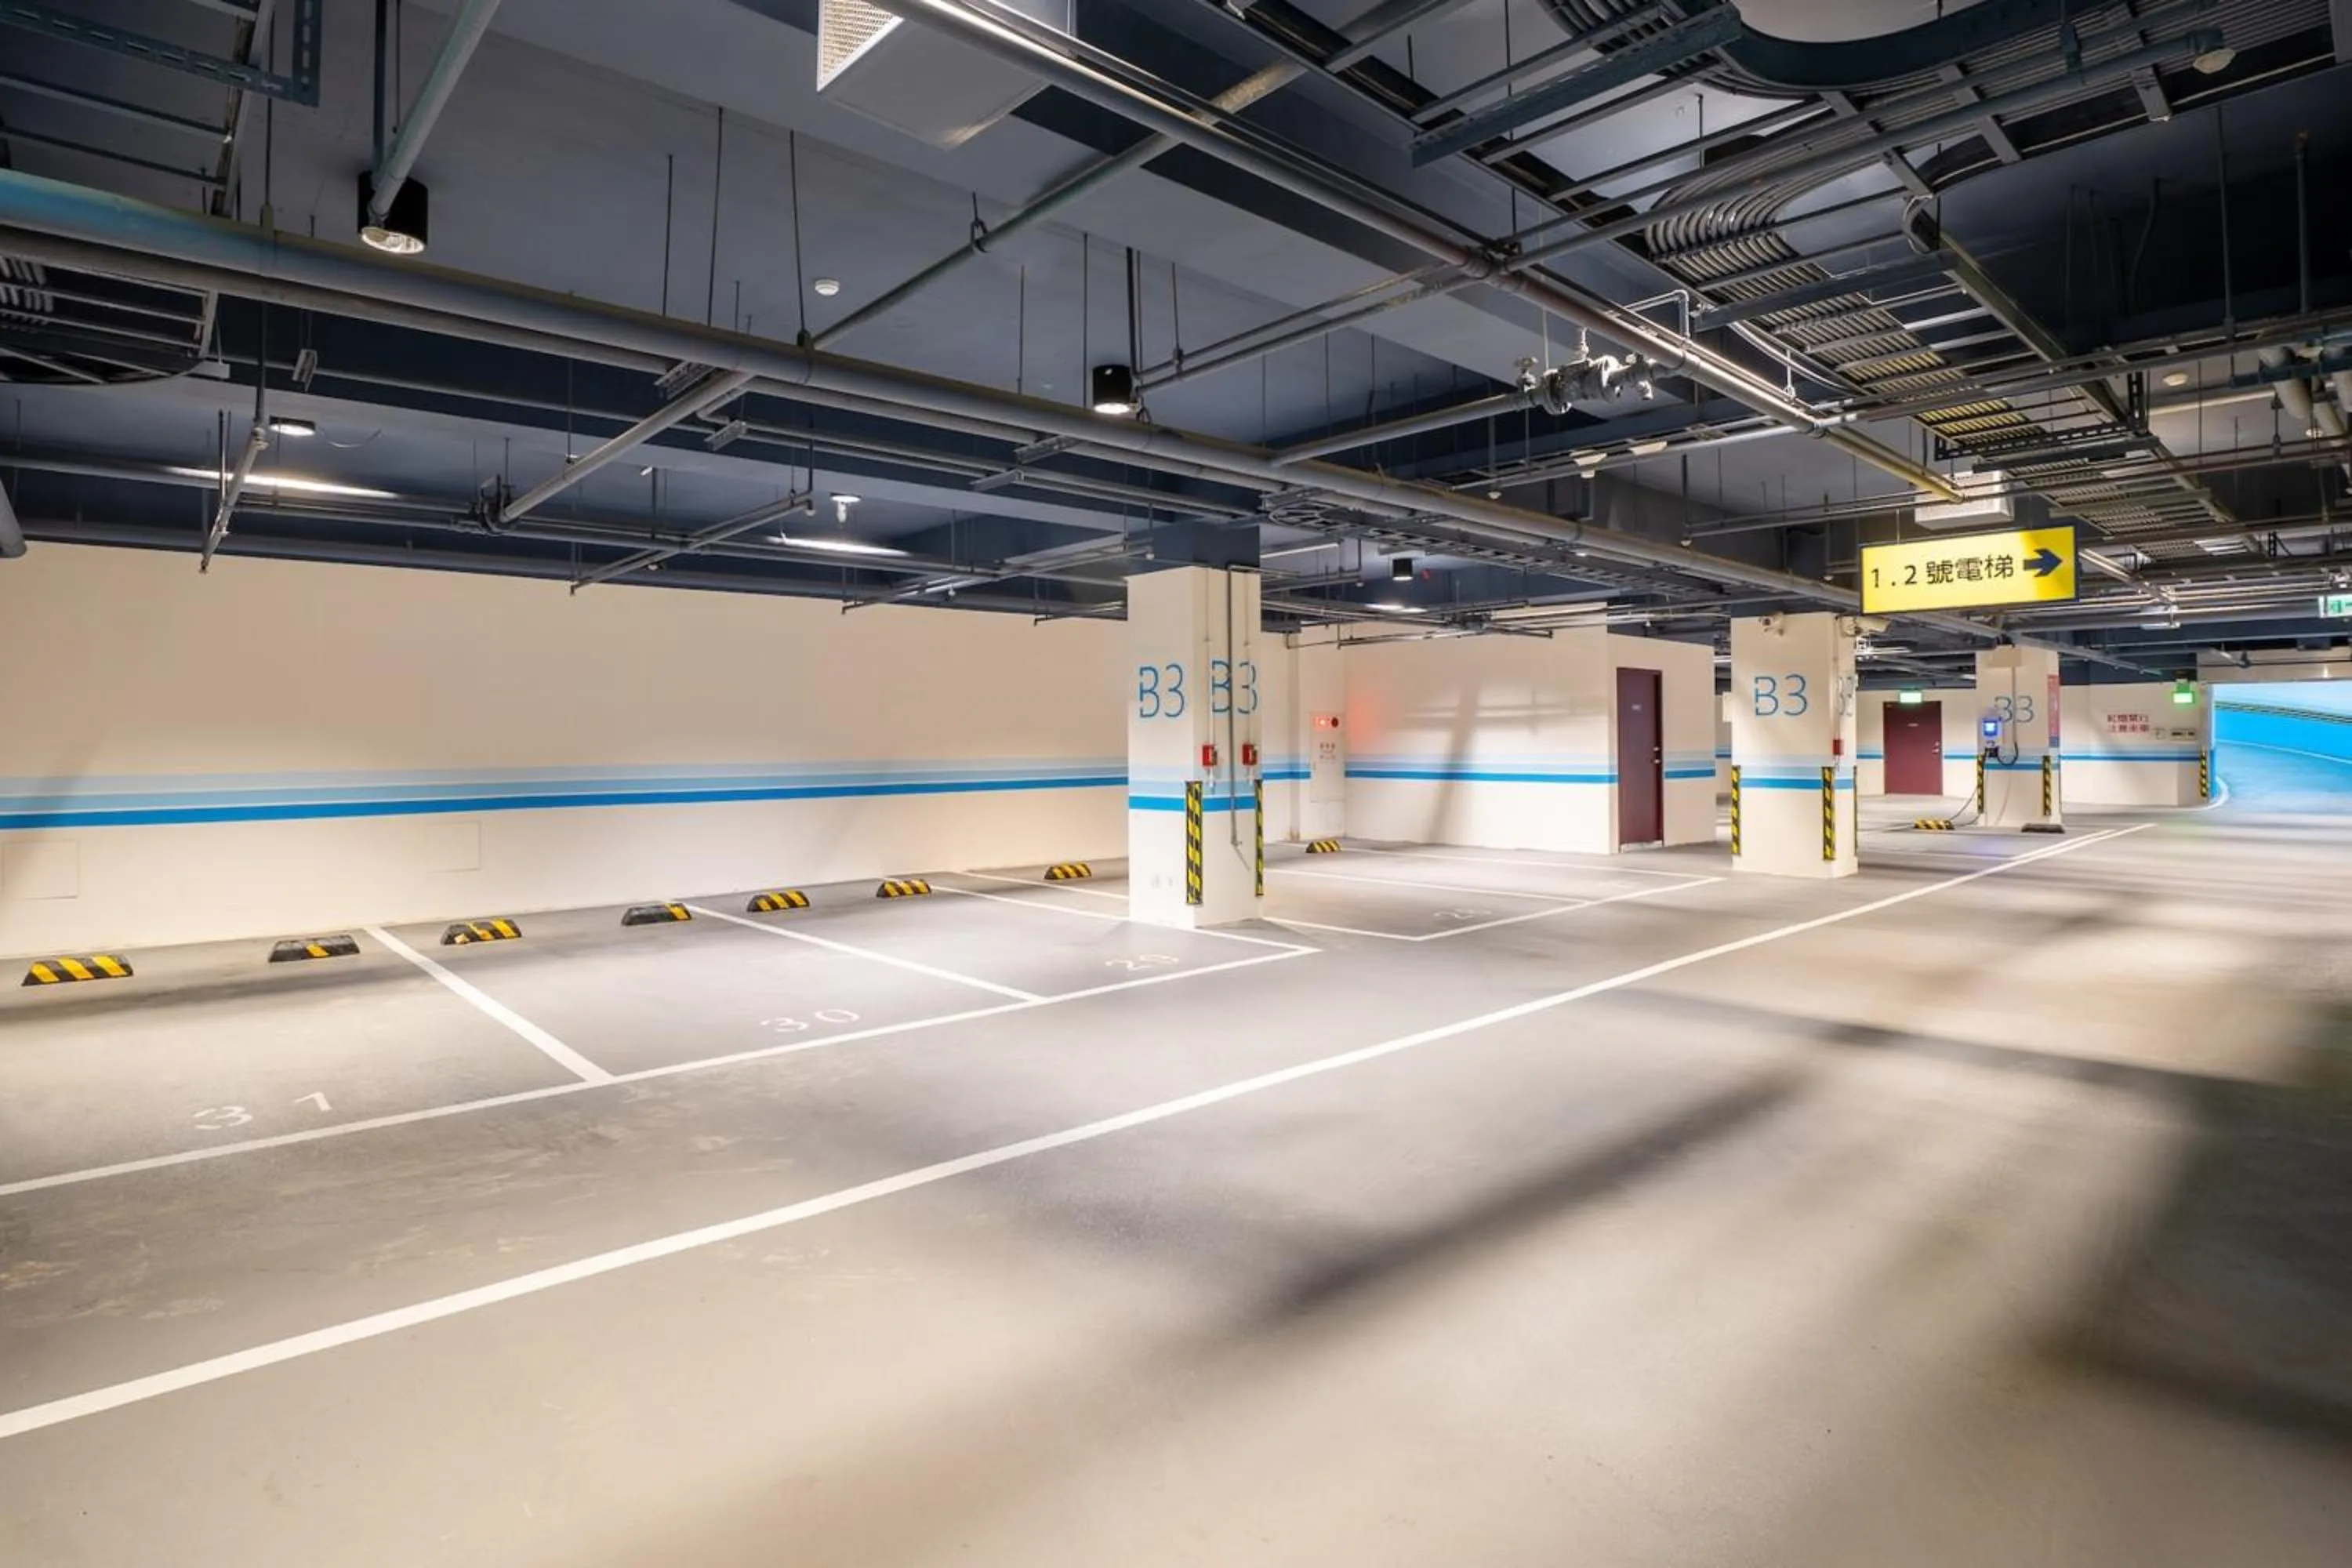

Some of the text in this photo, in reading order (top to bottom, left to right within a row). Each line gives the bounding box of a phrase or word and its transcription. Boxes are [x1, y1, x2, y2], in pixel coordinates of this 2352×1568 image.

[1139, 664, 1185, 717] B3
[1211, 660, 1258, 714] B3
[1755, 674, 1807, 716] B3
[760, 1008, 860, 1033] 30
[193, 1091, 332, 1130] 31
